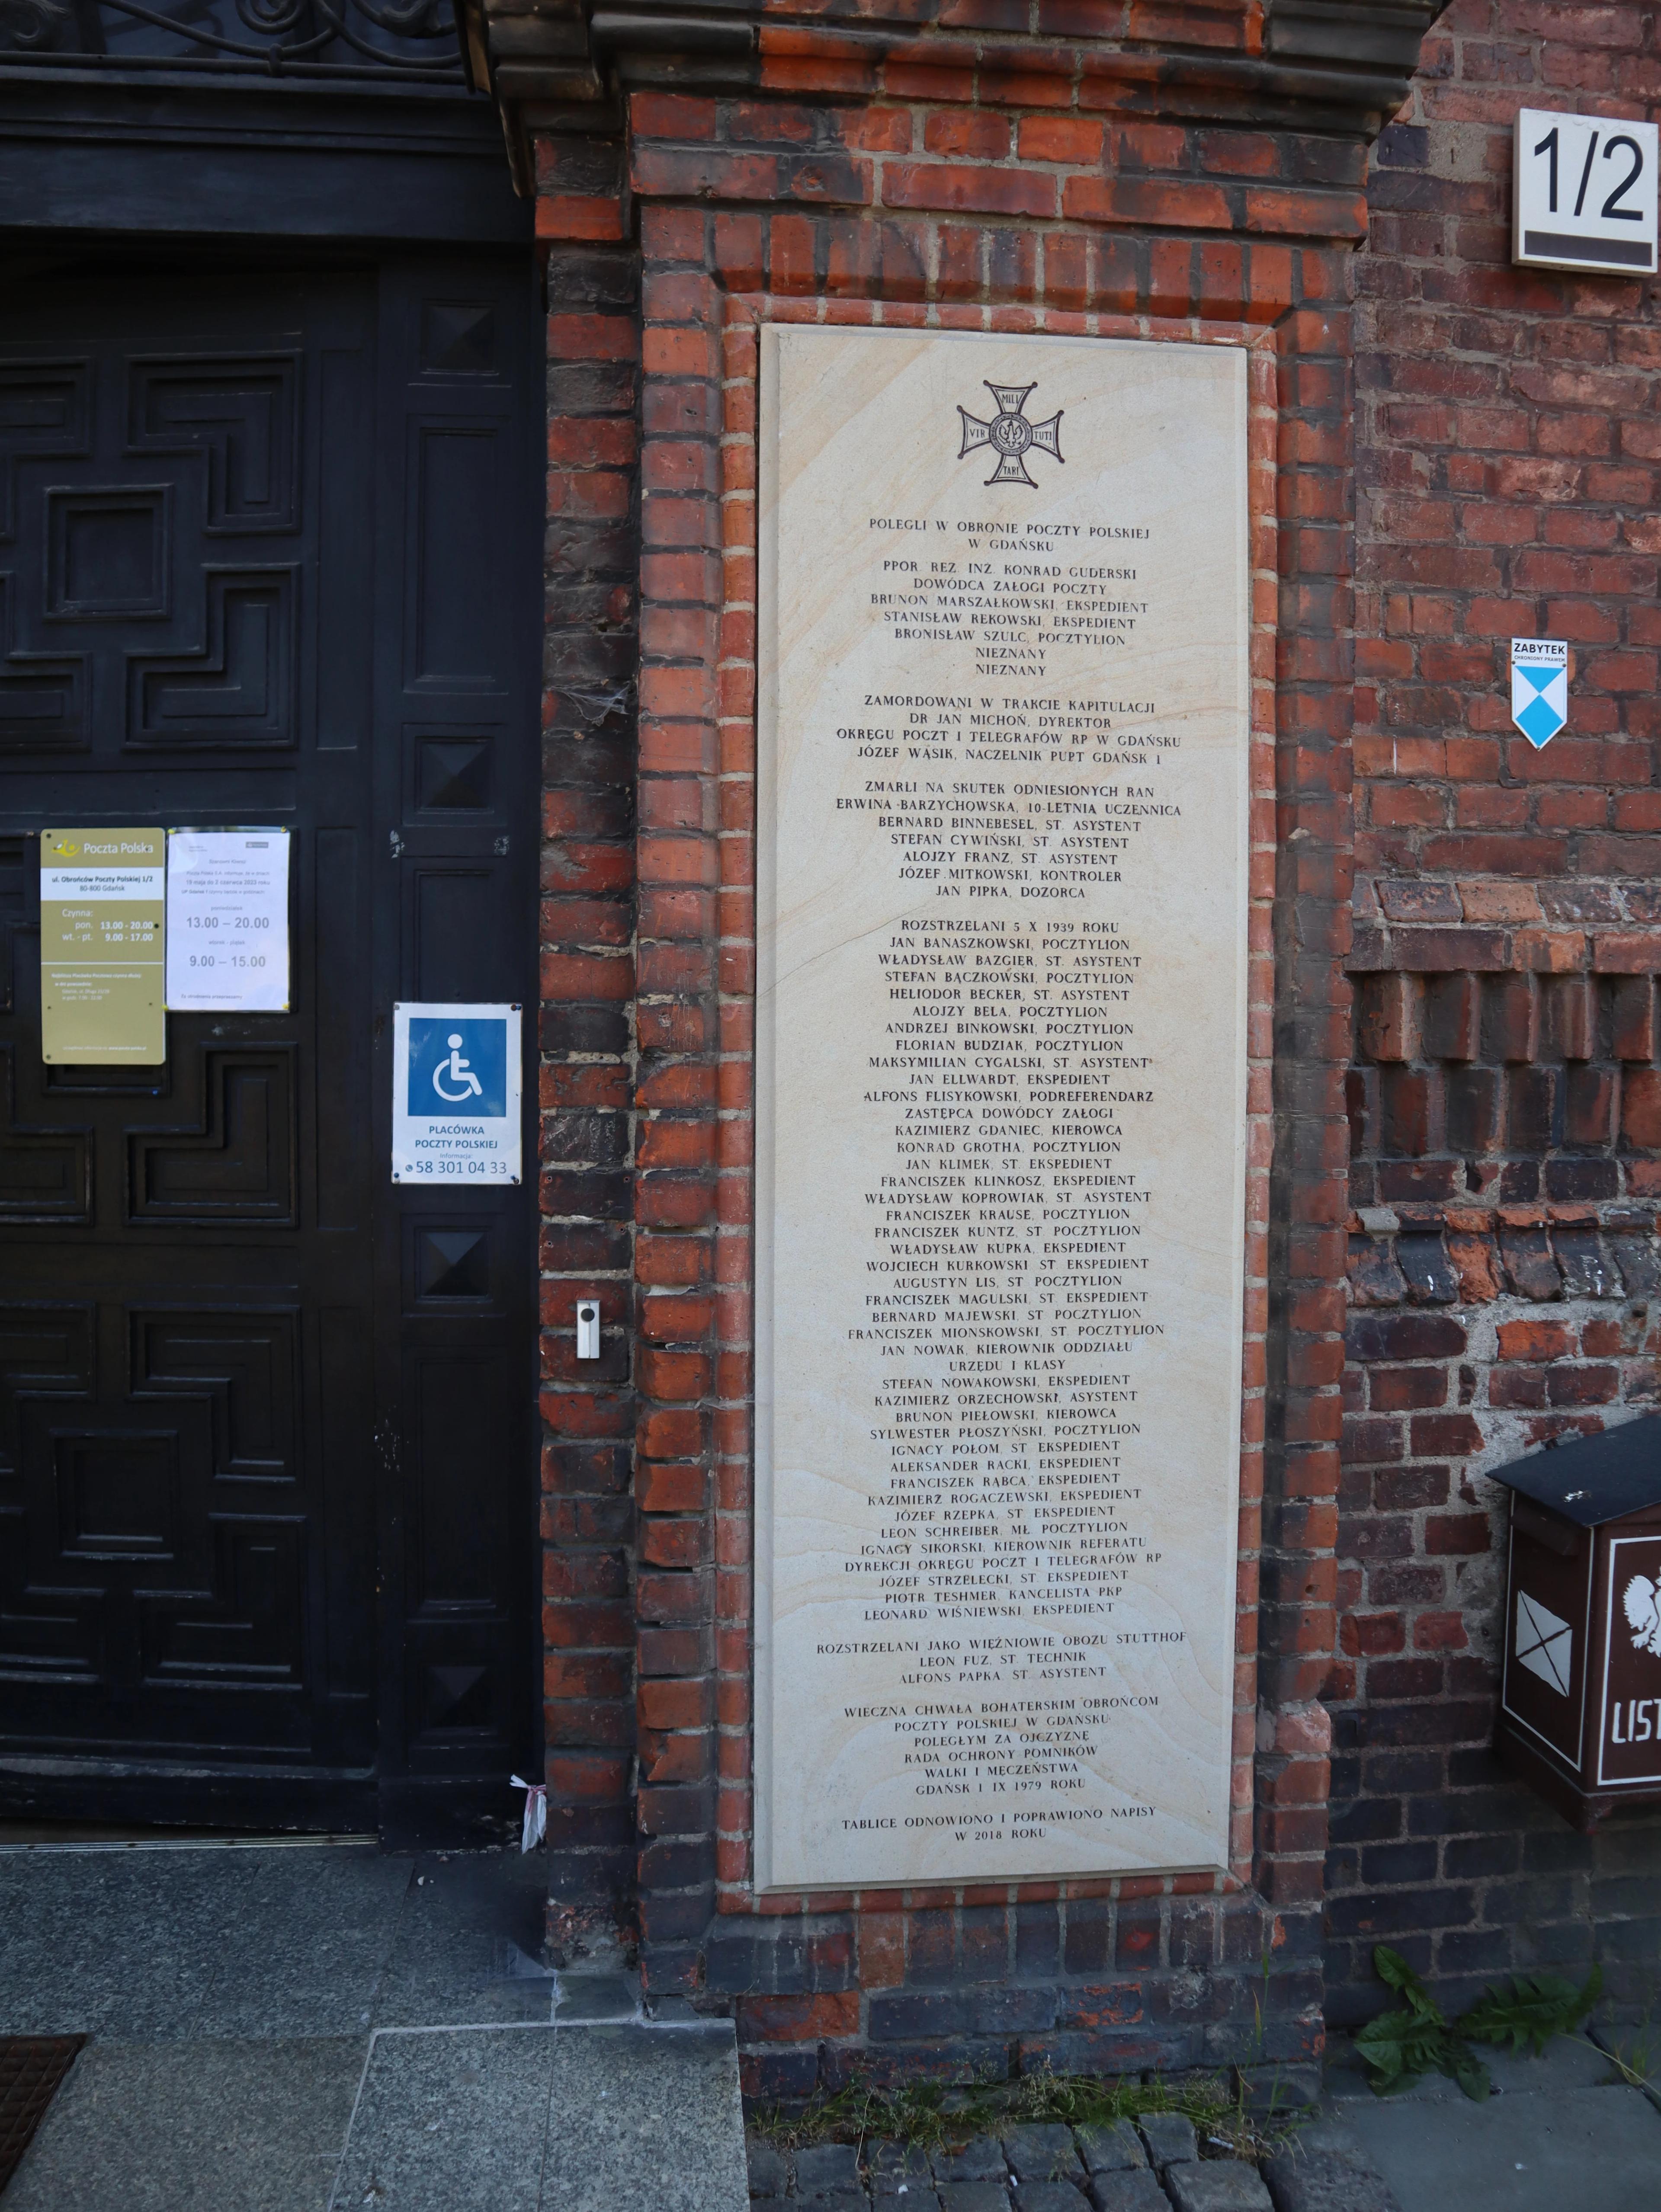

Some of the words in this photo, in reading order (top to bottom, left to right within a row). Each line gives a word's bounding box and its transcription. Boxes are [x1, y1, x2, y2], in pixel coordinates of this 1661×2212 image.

[1534, 127, 1643, 221] 1/2
[1002, 394, 1019, 403] MILI
[969, 429, 985, 438] VIR
[1034, 431, 1052, 440] TUTI
[1004, 466, 1019, 475] TARI
[870, 518, 927, 531] POLEGLI
[936, 520, 949, 532] W
[957, 521, 1018, 535] OBRONIE
[1026, 524, 1081, 537] POCZTY
[1090, 526, 1149, 539] POLSKIEJ
[968, 538, 981, 549] W
[989, 536, 1053, 552] GDAŃSKU
[914, 576, 985, 592] DOWÓDCA
[993, 580, 1045, 593] ZAŁOGI
[1053, 583, 1106, 595] POCZTY
[975, 647, 1046, 659] NIEZNANY
[1514, 643, 1565, 654] ZABYTEK
[976, 663, 1046, 676] NIEZNANY
[864, 695, 972, 708] ZAMORDOWANI
[980, 698, 994, 709] W
[1002, 698, 1060, 711] TRAKCIE
[1068, 700, 1154, 713] KAPITULACJI
[836, 728, 894, 743] OKRĘGU
[903, 730, 949, 742] POCZT
[969, 728, 1063, 745] TELEGRAFÓW
[1071, 733, 1088, 745] RP
[1096, 734, 1109, 746] W
[1117, 732, 1181, 747] GDAŃSKU
[865, 781, 917, 793] ZMARLI
[926, 782, 944, 794] NA
[952, 783, 1005, 795] SKUTEK
[1013, 784, 1118, 797] ODNIESIONYCH
[1126, 786, 1154, 798] RAN
[83, 843, 118, 854] Poczta
[120, 842, 154, 854] Polska
[62, 909, 93, 918] Czynna:
[75, 922, 93, 930] pon.
[100, 921, 123, 929] 13.00
[130, 921, 153, 929] 20.00
[186, 917, 218, 928] 13.00
[234, 917, 269, 928] 20.00
[901, 920, 1005, 932] ROZSTRZELANI
[1013, 921, 1020, 932] 5
[1029, 921, 1037, 932] X
[1047, 921, 1074, 933] 1939
[1083, 922, 1119, 933] ROKU
[189, 955, 215, 967] 9.00
[231, 956, 266, 967] 15.00
[913, 1006, 965, 1017] ALOJZY
[1020, 1006, 1107, 1018] POCZTYLION
[896, 1040, 956, 1051] FLORIAN
[1035, 1040, 1123, 1051] POCZTYLION
[905, 1108, 974, 1122] ZASTĘPCA
[982, 1105, 1054, 1119] DOWÓDCY
[1062, 1108, 1113, 1119] ZAŁOGI
[429, 1124, 484, 1134] PLACÓWKA
[415, 1140, 453, 1149] POCZTY
[455, 1140, 497, 1149] POLSKIEJ
[897, 1142, 955, 1153] KONRAD
[1033, 1141, 1120, 1153] POCZTYLION
[416, 1161, 433, 1173] 58
[438, 1161, 463, 1174] 301
[468, 1162, 485, 1174] 04
[491, 1162, 506, 1174] 33
[949, 1360, 1003, 1374] URZĘDU
[1024, 1359, 1065, 1371] KLASY
[882, 1378, 933, 1390] STEFAN
[1049, 1375, 1130, 1387] EKSPEDIENT
[870, 1427, 950, 1440] SYLWESTER
[1054, 1424, 1140, 1436] POCZTYLION
[817, 1640, 918, 1655] ROZSTRZELANI
[927, 1639, 960, 1651] JAKO
[969, 1633, 1055, 1652] WIĘŹNIOWIE
[1063, 1634, 1108, 1646] OBOZU
[1116, 1631, 1186, 1645] STUTTHOF
[844, 1705, 906, 1718] WIECZNA
[915, 1703, 972, 1716] CHWAŁA
[981, 1699, 1075, 1713] BOHATERSKIM
[1083, 1693, 1158, 1710] OBROŃCOM
[914, 1734, 986, 1748] POLEGŁYM
[994, 1733, 1011, 1745] ZA
[1020, 1730, 1089, 1747] OJCZYZNĘ
[904, 1751, 940, 1764] RADA
[948, 1748, 1016, 1762] OCHRONY
[1024, 1743, 1098, 1759] POMNIKÓW
[841, 1817, 897, 1831] TABLICE
[904, 1813, 993, 1828] ODNOWIONO
[1013, 1808, 1103, 1823] POPRAWIONO
[1111, 1806, 1156, 1819] NAPISY
[955, 1830, 967, 1842] W
[975, 1829, 1002, 1841] 2018
[1011, 1828, 1046, 1840] ROKU
